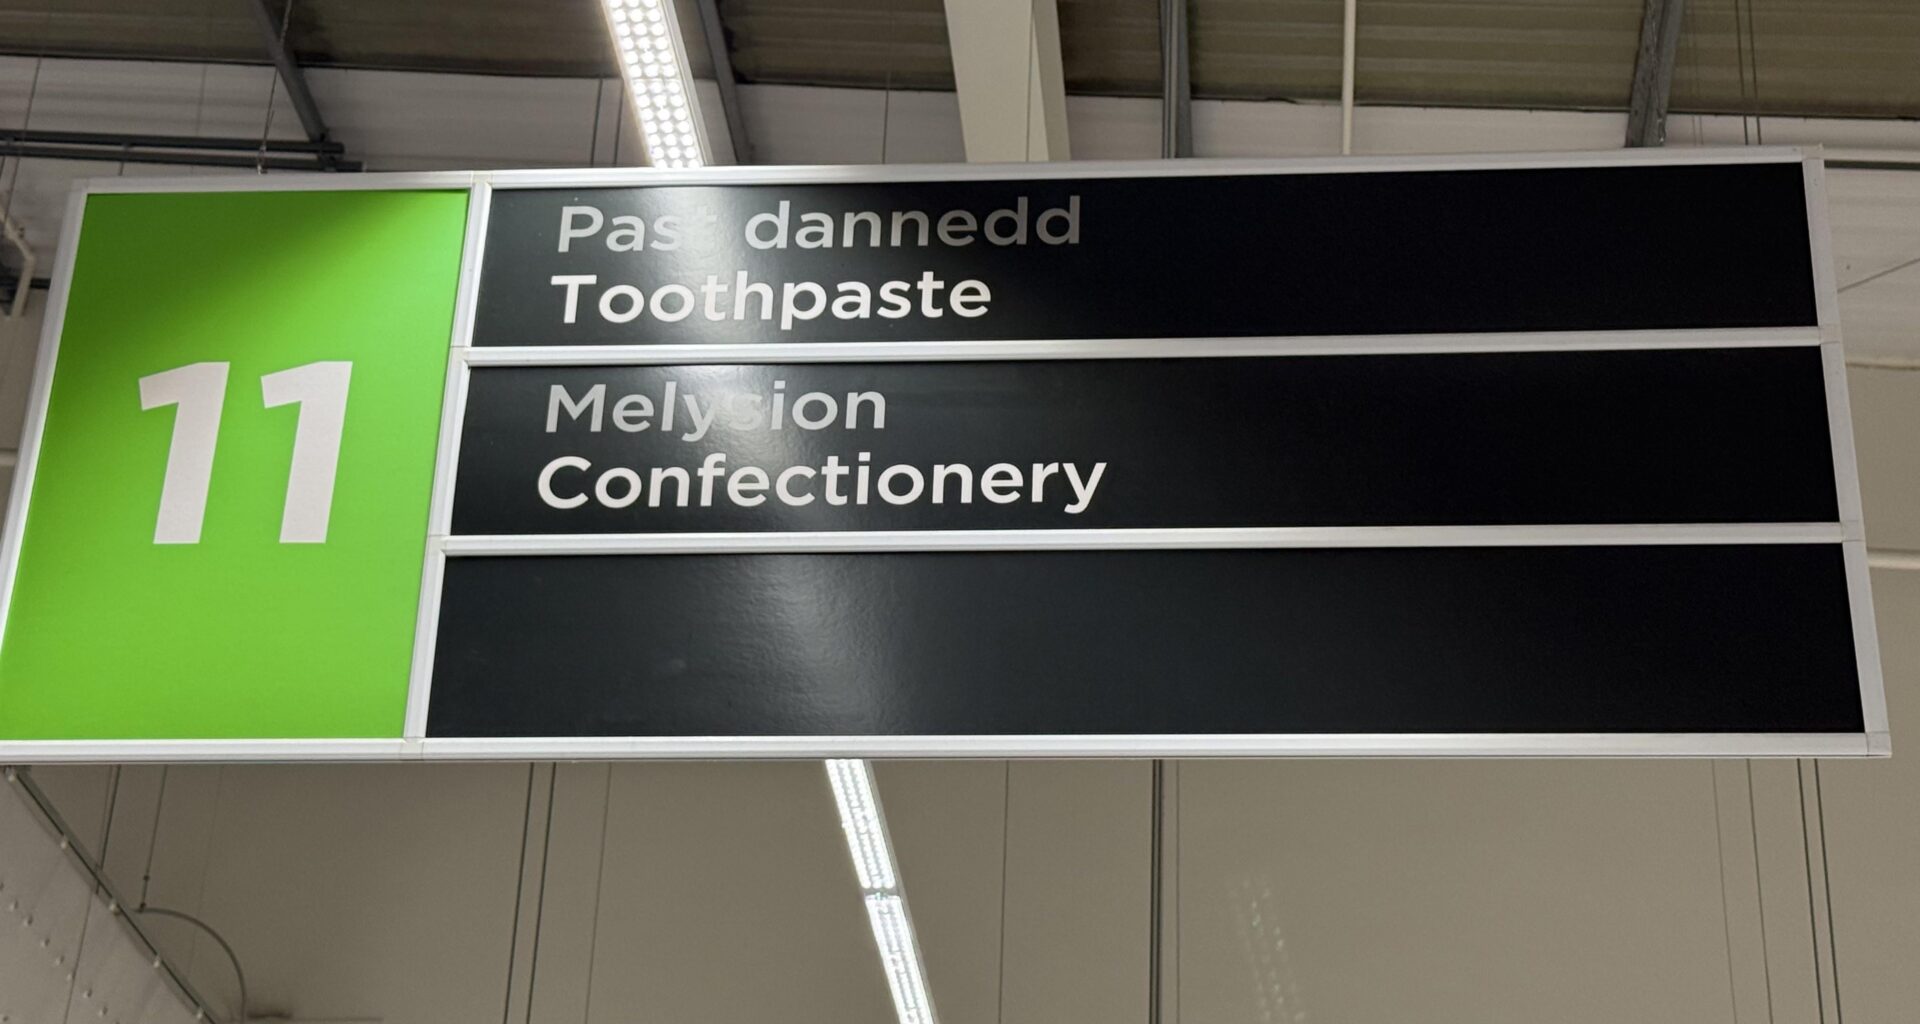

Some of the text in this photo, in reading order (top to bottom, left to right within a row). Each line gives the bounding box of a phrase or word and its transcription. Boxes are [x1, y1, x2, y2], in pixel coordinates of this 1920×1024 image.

[745, 195, 1082, 250] dannedd
[551, 270, 992, 330] Toothpaste
[545, 380, 887, 441] Melysion
[138, 360, 353, 544] 11
[537, 452, 1108, 514] Confectionery
